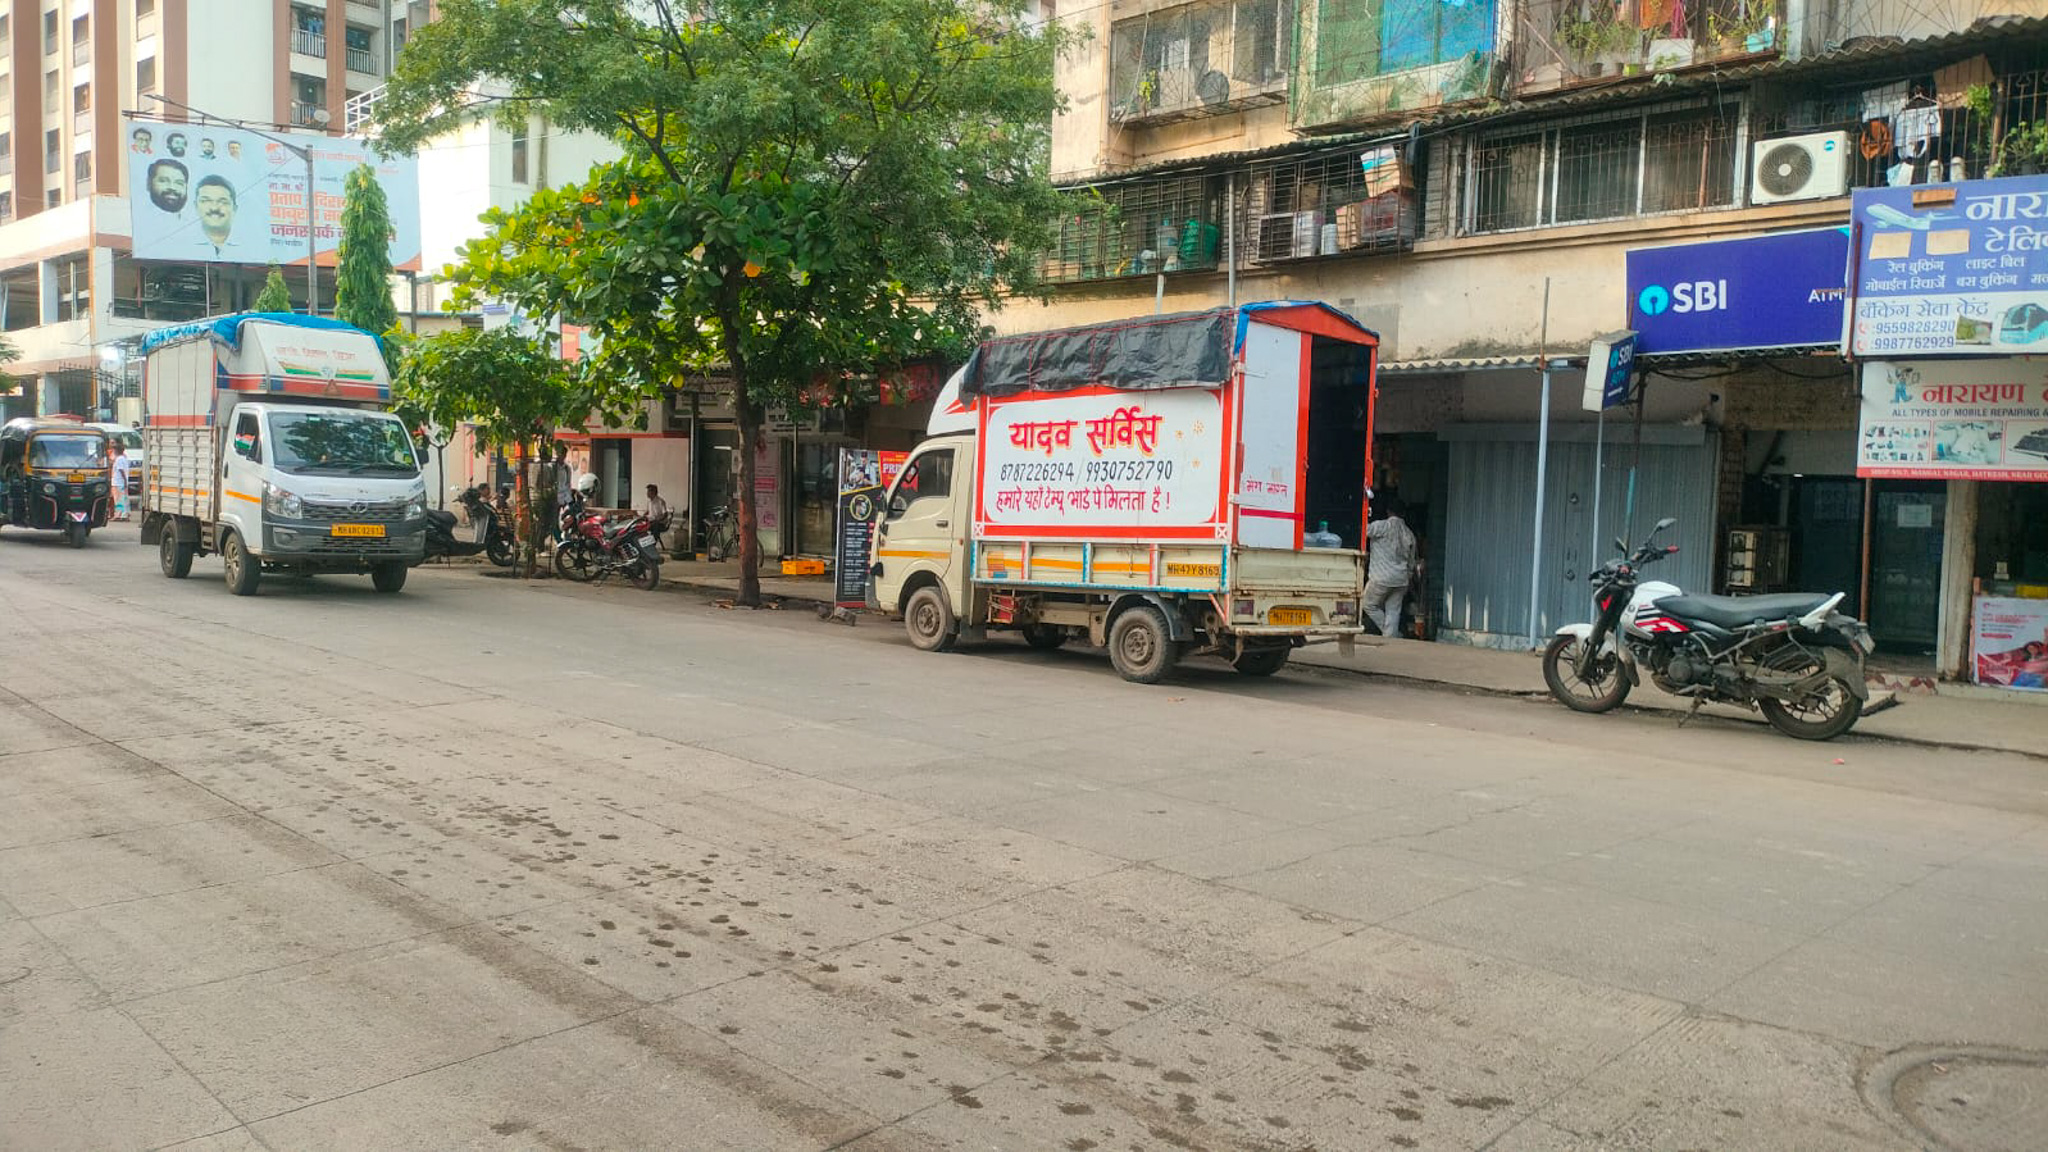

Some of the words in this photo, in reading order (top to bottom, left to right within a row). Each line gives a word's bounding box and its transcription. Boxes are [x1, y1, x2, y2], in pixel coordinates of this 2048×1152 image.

[1966, 192, 2048, 221] नार
[1672, 279, 1728, 313] SBI
[1807, 286, 1844, 303] ATM
[1618, 343, 1634, 367] SBI
[1921, 383, 2027, 404] नारायण
[1892, 408, 1908, 417] ALL
[1911, 408, 1938, 417] TYPES
[1939, 408, 1952, 417] OF
[1954, 408, 1988, 417] MOBILE
[1990, 408, 2040, 418] REPAIRING
[1009, 419, 1079, 456] यादव
[1085, 405, 1166, 457] सर्विस
[1000, 461, 1075, 482] 8787226294
[1086, 459, 1173, 482] 9930752790
[996, 485, 1022, 513] हमारे
[1103, 483, 1146, 511] मिलता
